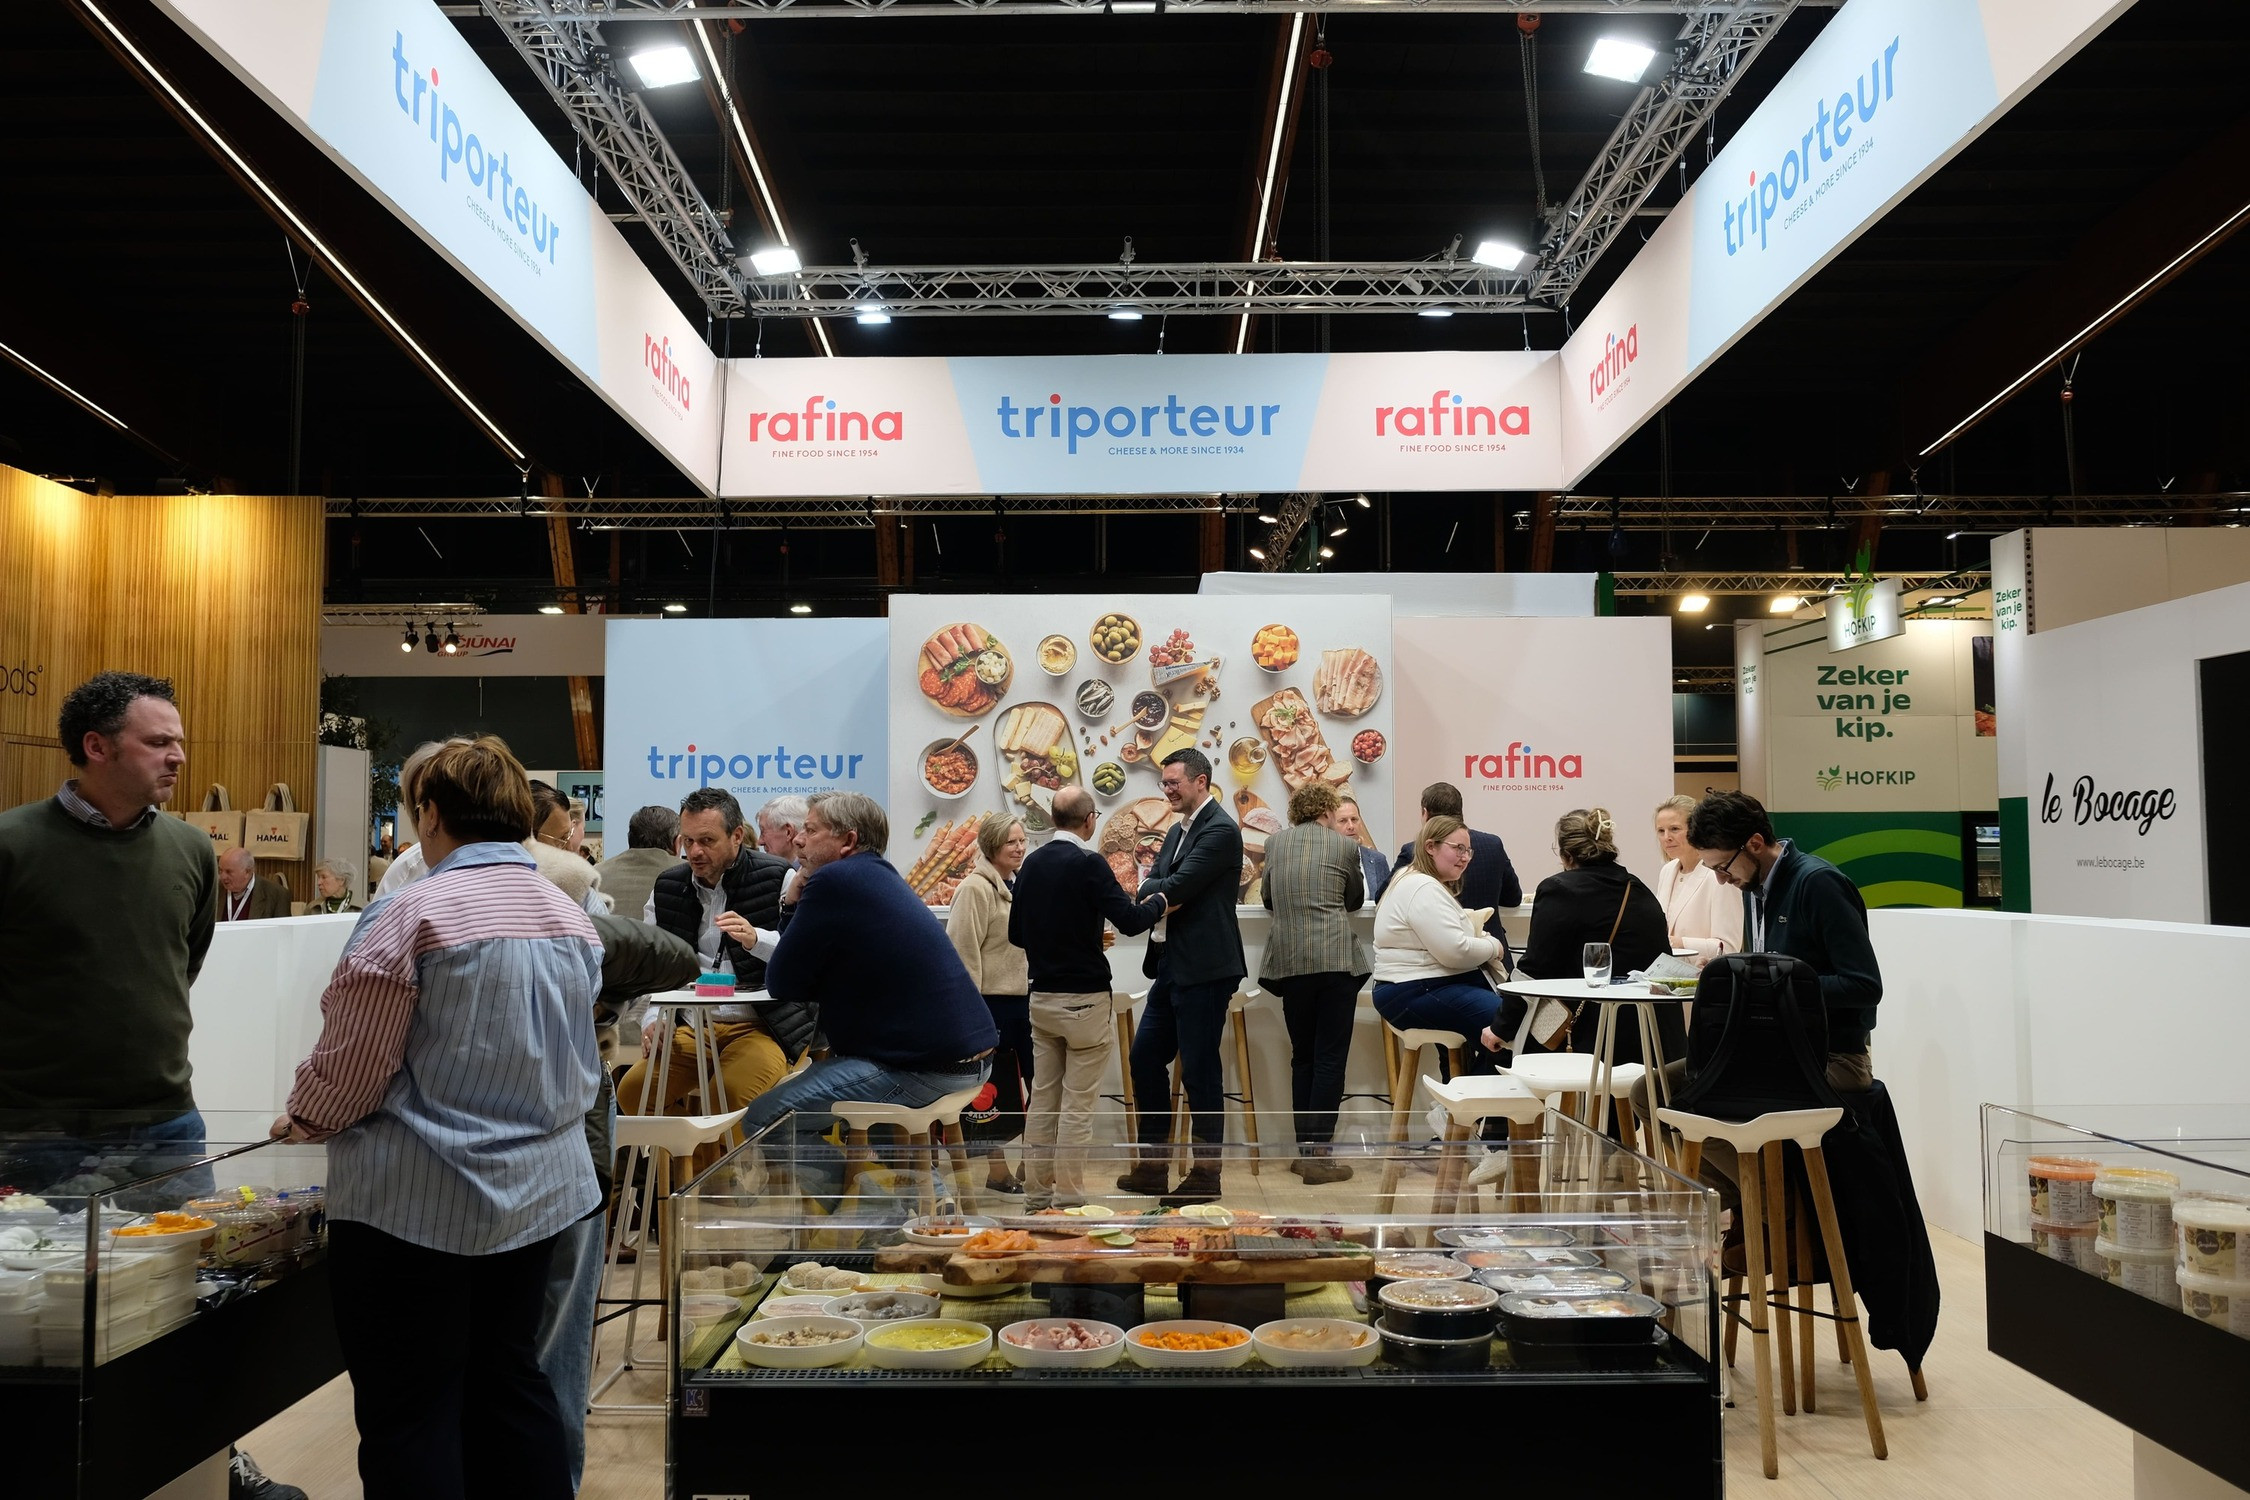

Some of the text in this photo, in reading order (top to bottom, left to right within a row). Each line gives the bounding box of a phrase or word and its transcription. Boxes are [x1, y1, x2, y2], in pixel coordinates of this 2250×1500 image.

[392, 29, 560, 266] triporteur
[1723, 34, 1900, 257] triporteur
[1783, 199, 1808, 230] CHEESE
[1815, 173, 1835, 201] MORE
[1835, 151, 1858, 181] SINCE
[1858, 136, 1874, 159] 1934
[466, 194, 491, 228] CHEESE
[644, 332, 690, 412] rafina
[1589, 322, 1638, 404] rafina
[749, 395, 903, 442] rafina
[997, 393, 1281, 455] triporteur
[1375, 389, 1530, 437] rafina
[772, 449, 878, 458] FINE FOOD SINCE 1954
[1108, 445, 1245, 456] CHEESE & MORE SINCE 1934
[1400, 444, 1506, 453] FINE FOOD SINCE 1954
[1995, 588, 2022, 604] Zeker
[1995, 601, 2022, 618] van je
[1843, 615, 1876, 638] HOFKIP
[2001, 617, 2018, 631] kip.
[1817, 665, 1910, 686] Zeker
[1816, 688, 1911, 715] van je
[1836, 716, 1894, 743] kip.
[647, 744, 864, 788] triporteur
[1464, 741, 1582, 779] rafina
[731, 786, 761, 794] CHEESE
[762, 786, 769, 794] &
[770, 786, 792, 794] MORE
[794, 786, 817, 794] SINCE
[1846, 770, 1916, 785] HOFKIP
[2041, 772, 2177, 836] le Bocage
[209, 833, 229, 841] MAL
[256, 834, 289, 842] HAMAL
[2076, 856, 2145, 871] www.lebocage.be
